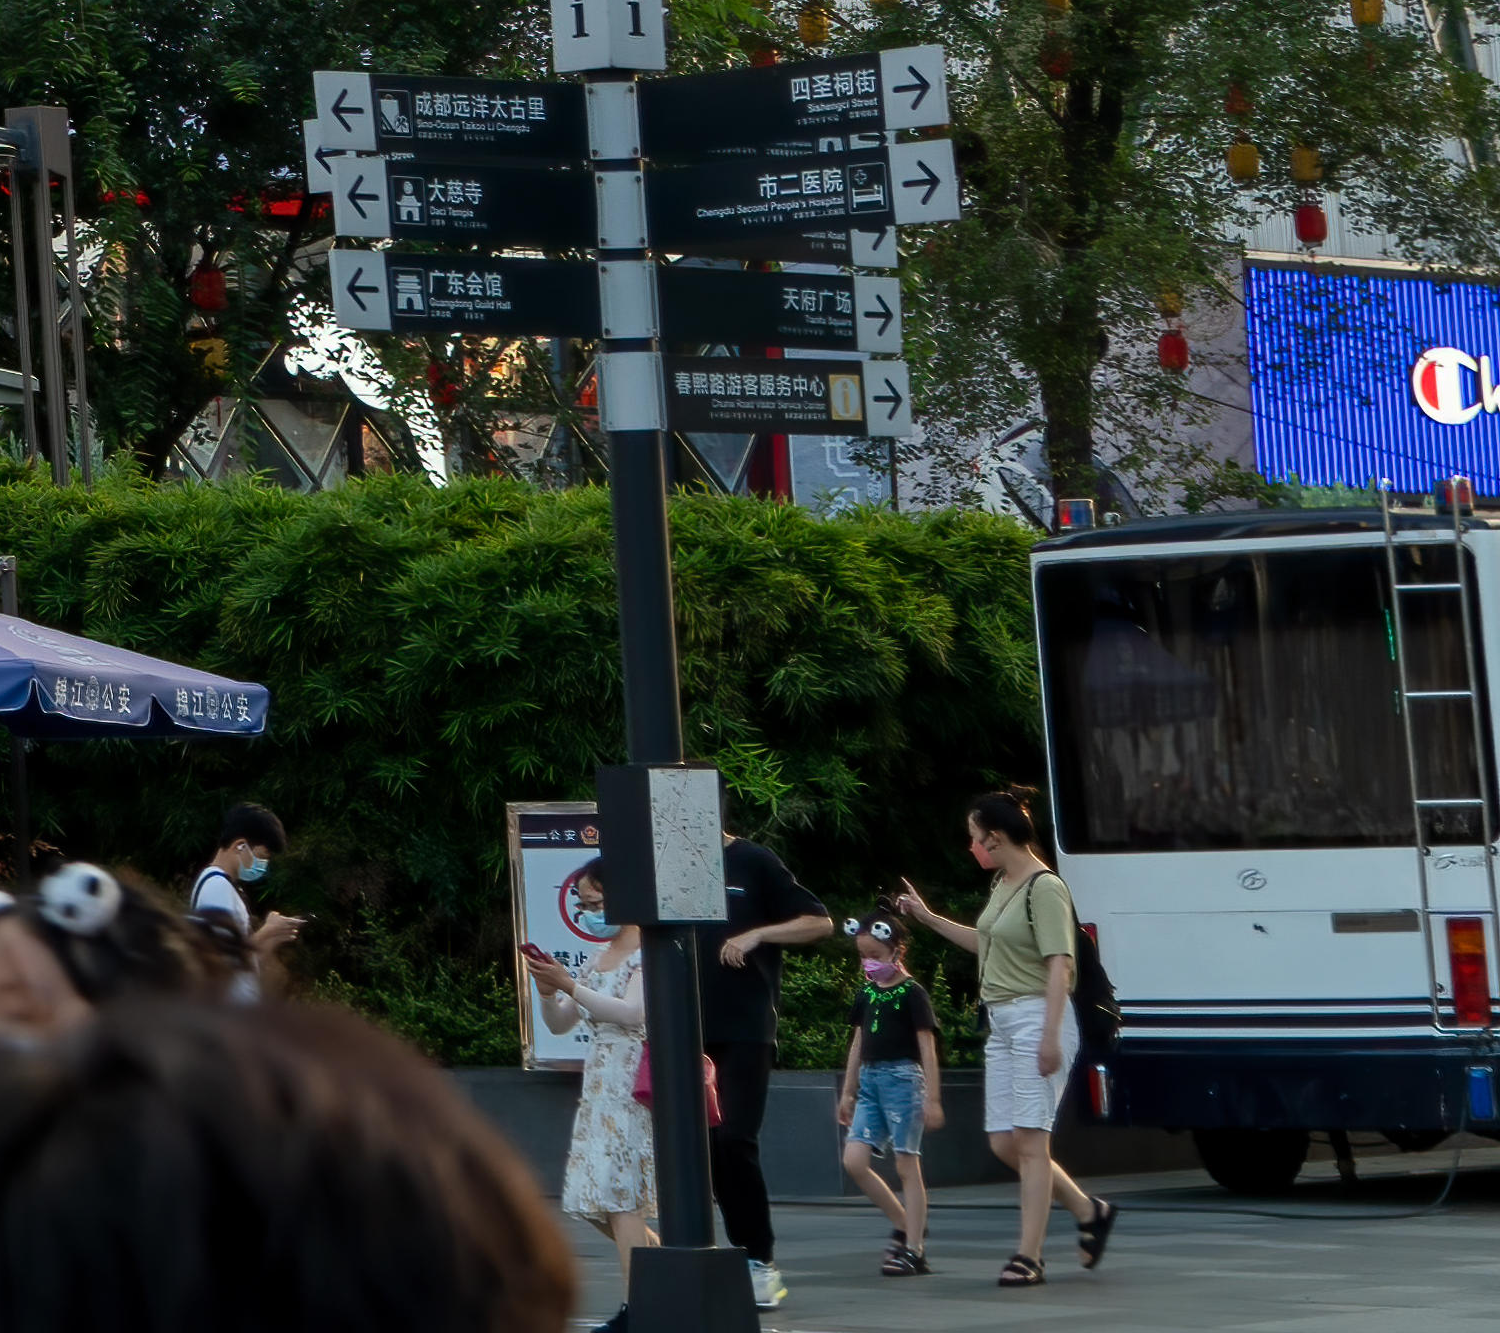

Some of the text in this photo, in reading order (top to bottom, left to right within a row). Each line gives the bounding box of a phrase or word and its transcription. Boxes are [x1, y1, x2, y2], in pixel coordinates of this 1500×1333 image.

[791, 68, 877, 103] 四圣祠街
[414, 91, 547, 121] 成都远洋太古里
[851, 96, 878, 108] Street
[495, 122, 531, 135] Chengdu
[427, 177, 484, 206] 大慈寺
[757, 166, 844, 201] 市二医院
[696, 206, 736, 219] Chengdu
[736, 202, 769, 214] Second
[770, 199, 806, 212] People's
[808, 194, 845, 208] Hospital
[428, 269, 504, 298] 广东会馆
[782, 287, 852, 315] 天府广场
[674, 371, 826, 399] 春熙路游客服务中心
[1412, 346, 1500, 425] Ch
[549, 829, 577, 842] 公安
